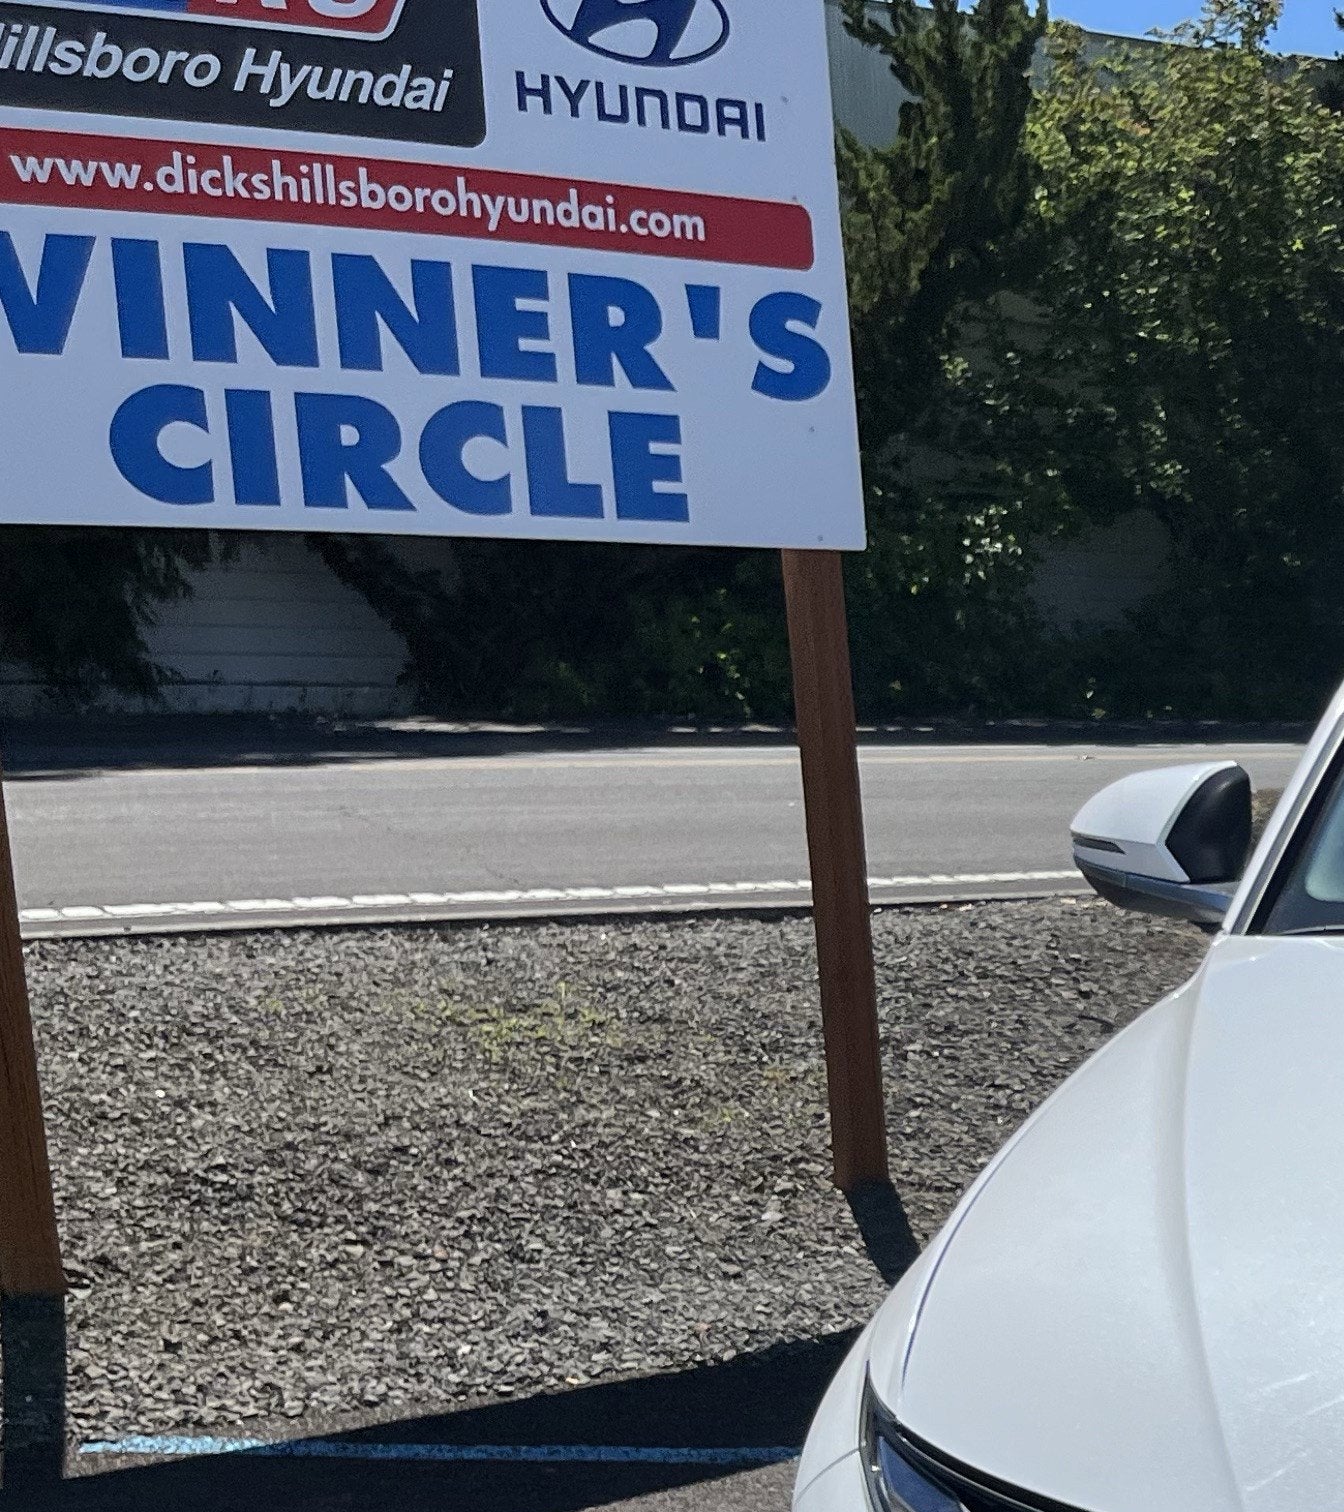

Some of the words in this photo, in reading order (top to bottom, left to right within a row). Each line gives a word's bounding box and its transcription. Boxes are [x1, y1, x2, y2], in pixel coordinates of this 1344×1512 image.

[0, 22, 220, 88] illsboro
[233, 48, 454, 113] Hyundai
[515, 70, 767, 142] HYUNDAI
[10, 150, 706, 242] www.dickshillsborohyundai.com
[109, 383, 690, 523] CIRCLE
